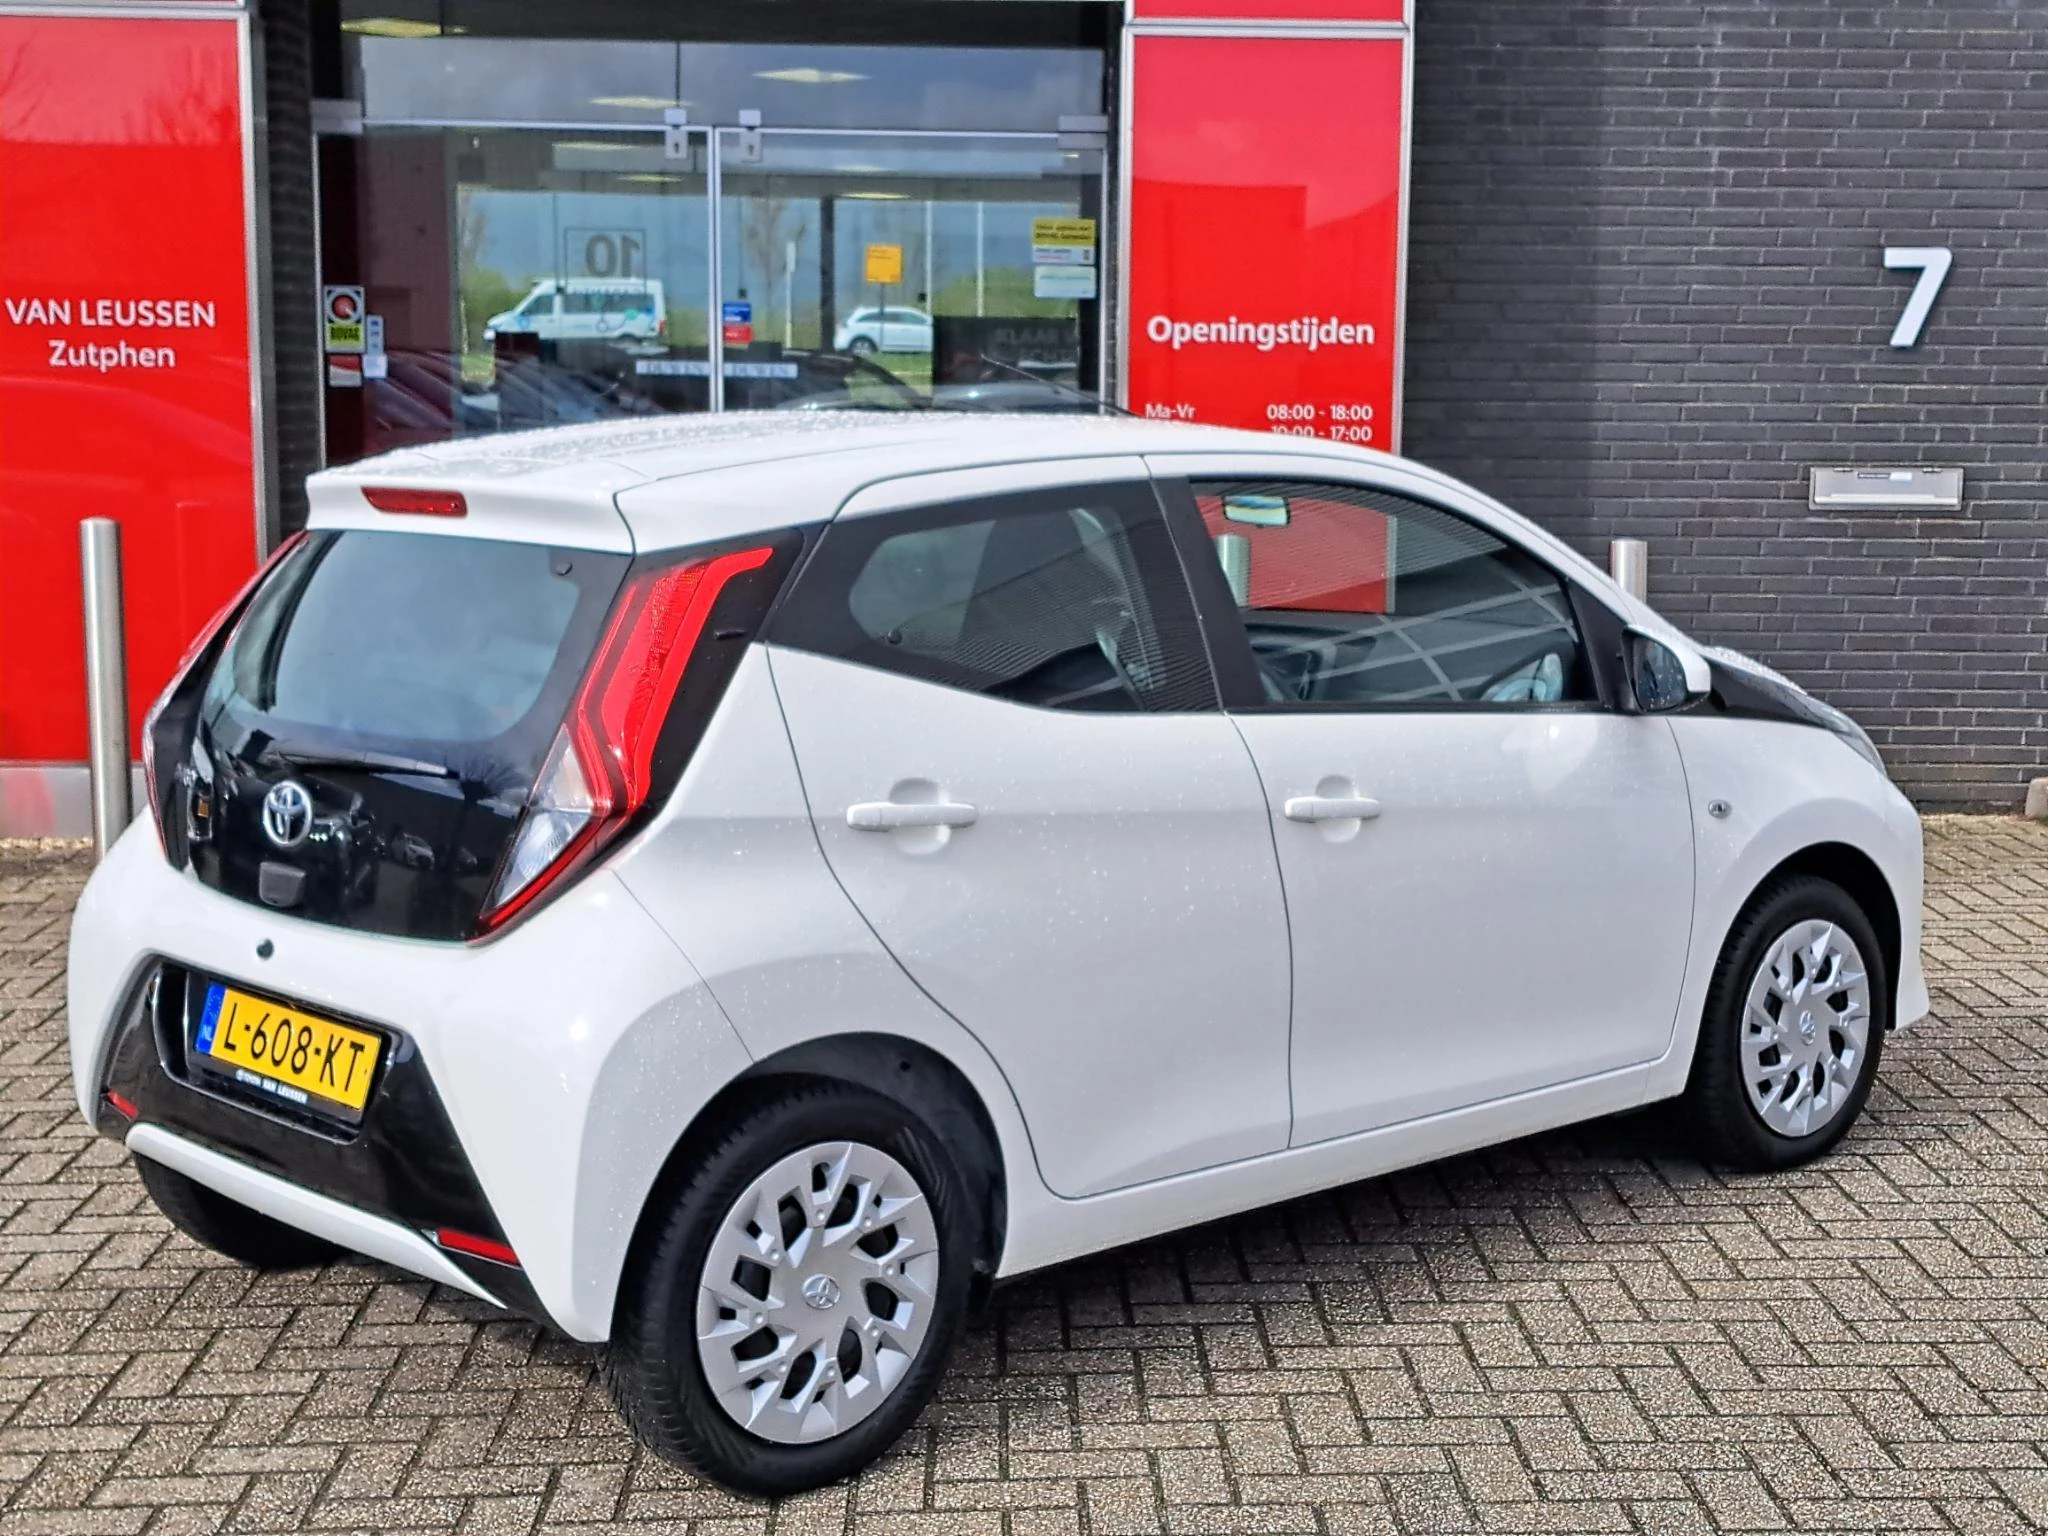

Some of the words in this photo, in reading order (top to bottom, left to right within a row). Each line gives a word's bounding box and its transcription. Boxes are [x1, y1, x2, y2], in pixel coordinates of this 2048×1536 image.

[6, 299, 72, 326] VAN
[80, 299, 216, 327] LEUSSEN
[1883, 247, 1952, 346] 7
[1147, 315, 1375, 350] Openingstijden
[49, 339, 176, 372] Zutphen
[1145, 403, 1195, 419] Ma-Vr
[1266, 404, 1315, 420] 08:00
[1330, 404, 1373, 420] 18:00
[1329, 425, 1373, 442] 17:00
[223, 1002, 366, 1092] L-608-KT
